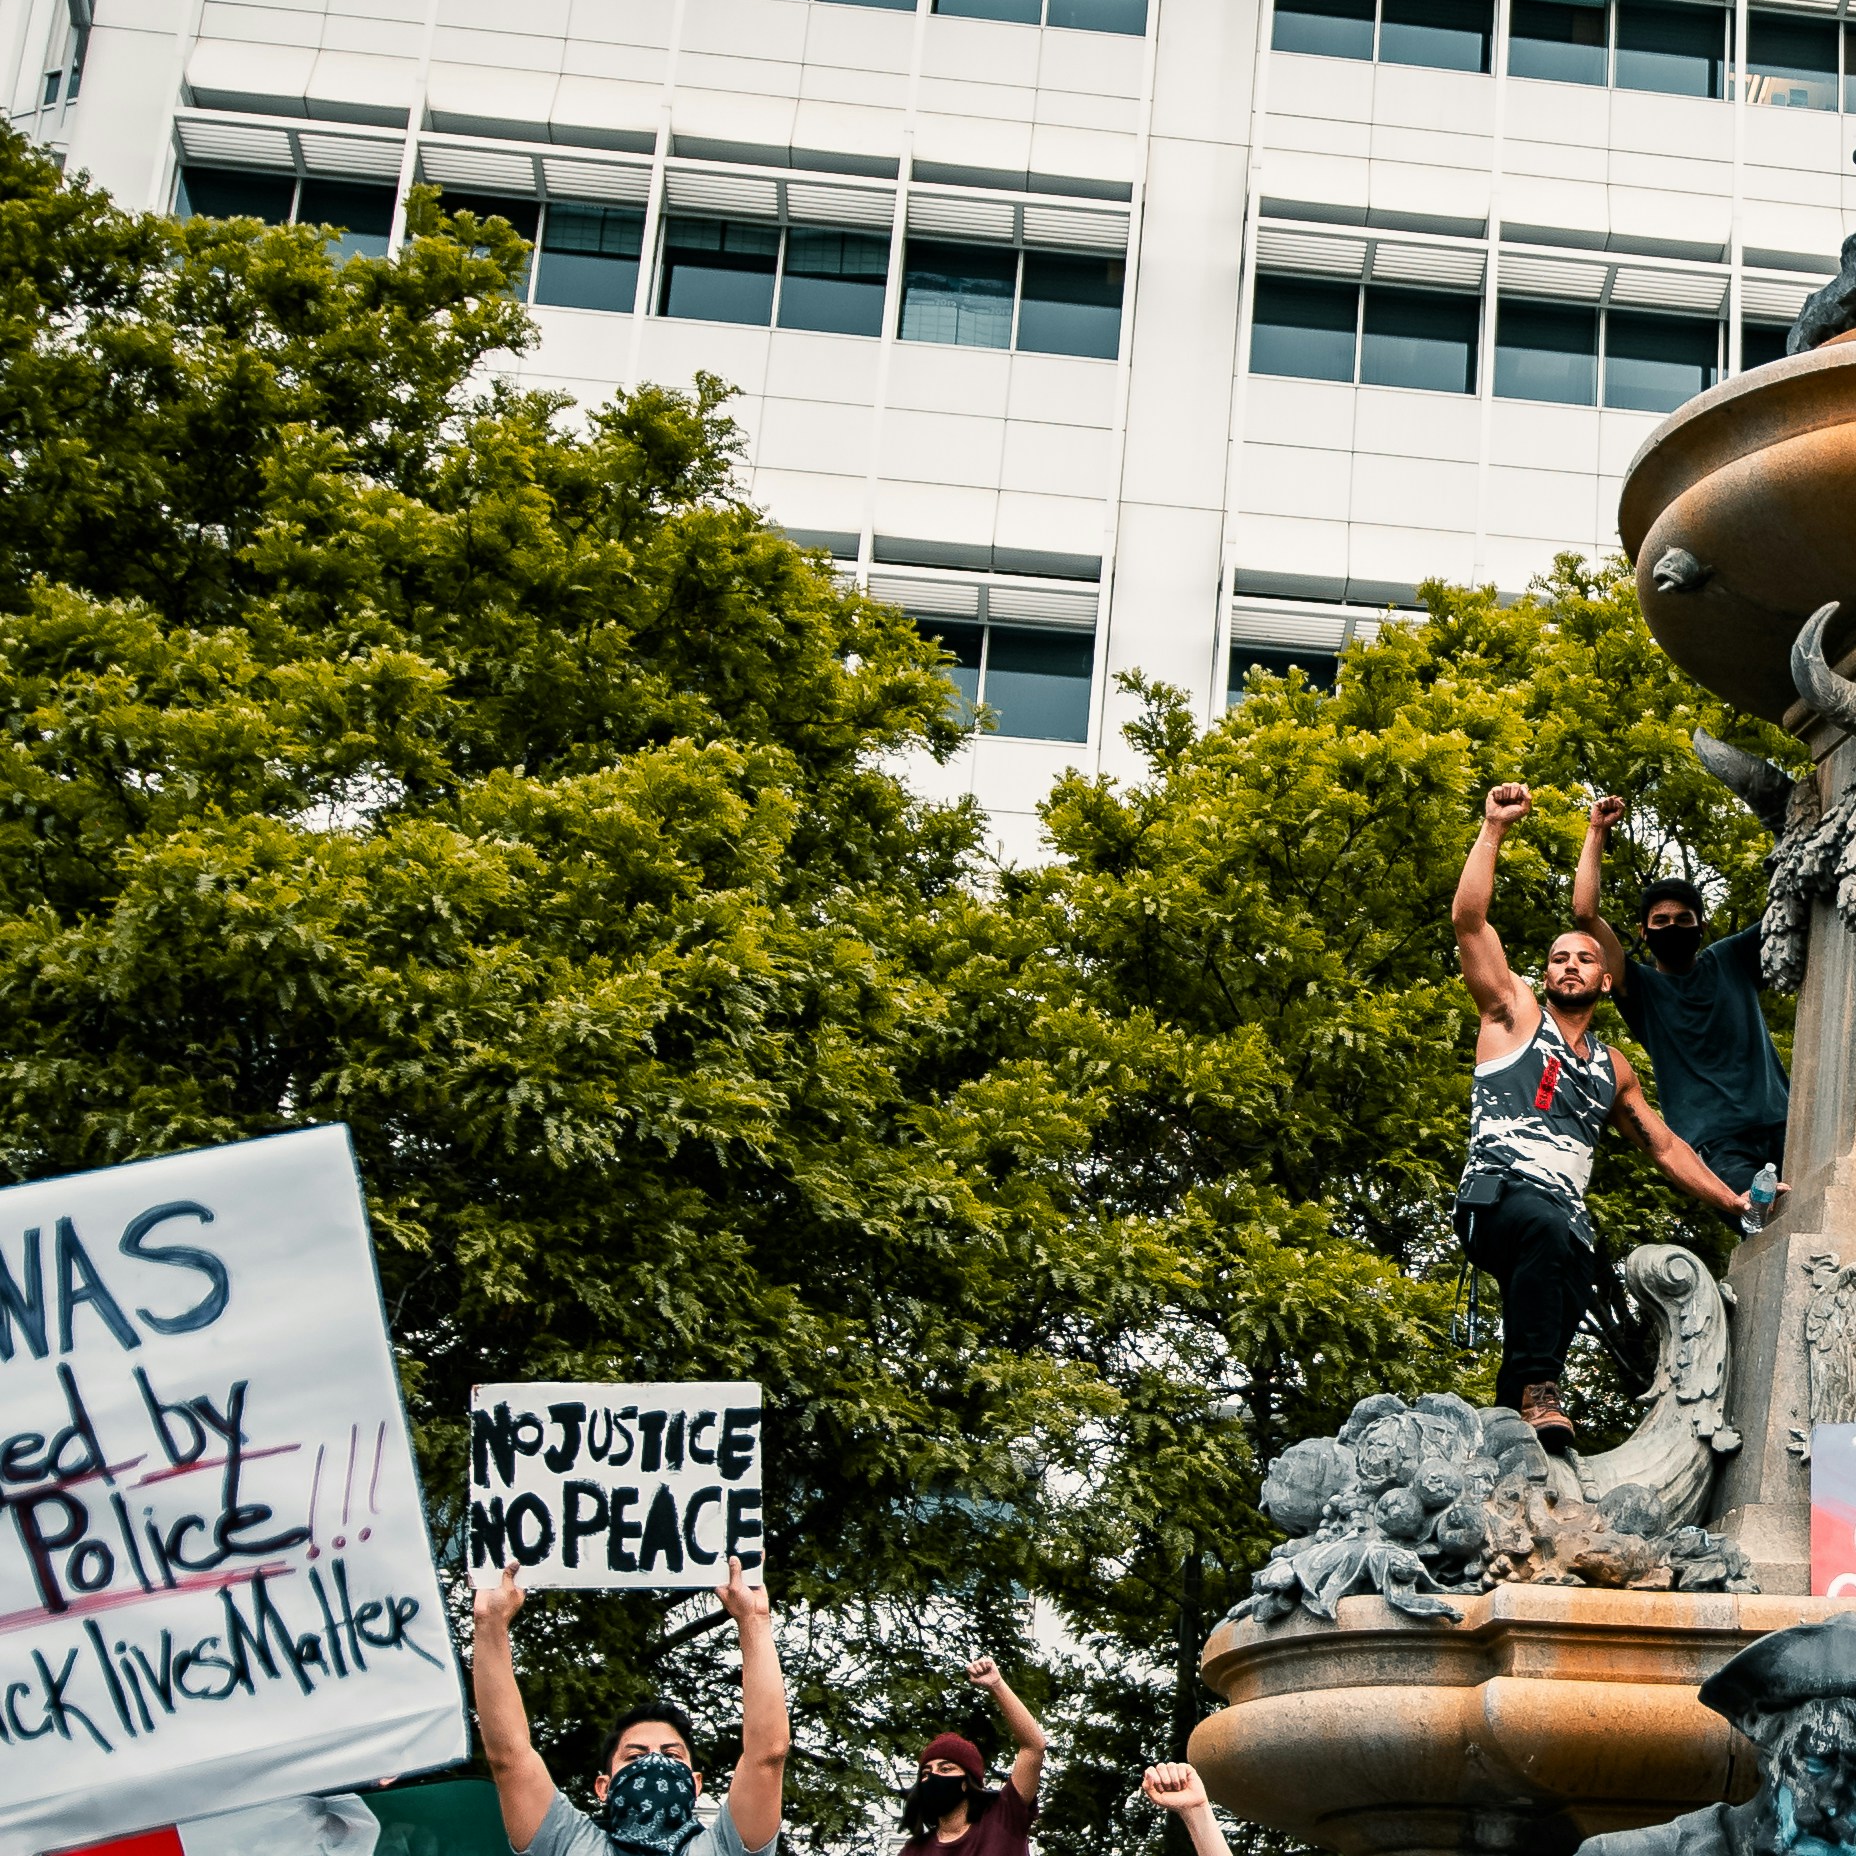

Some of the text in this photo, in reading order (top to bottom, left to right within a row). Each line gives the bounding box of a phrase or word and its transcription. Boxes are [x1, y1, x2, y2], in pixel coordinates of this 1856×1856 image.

[544, 1401, 762, 1481] JUSTICE
[469, 1480, 763, 1574] NO PEACE
